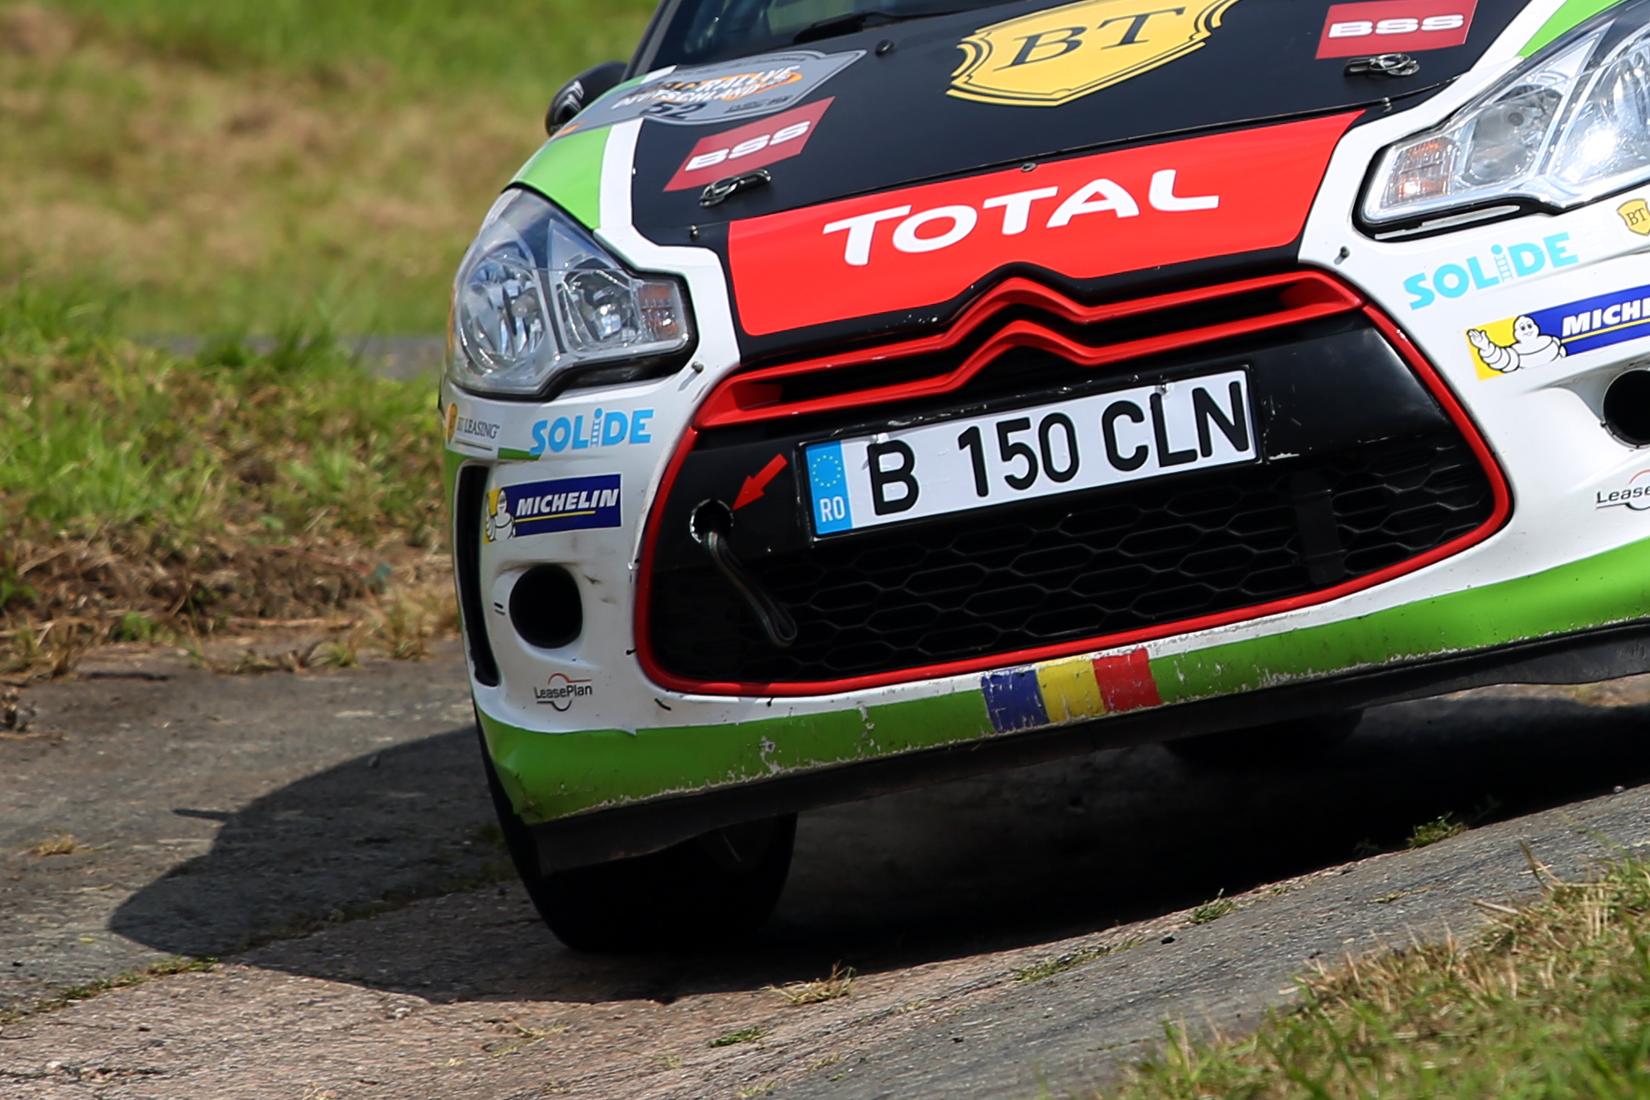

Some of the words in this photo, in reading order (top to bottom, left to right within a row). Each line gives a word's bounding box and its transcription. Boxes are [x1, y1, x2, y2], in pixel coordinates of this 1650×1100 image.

[992, 6, 1186, 72] BT
[1328, 14, 1465, 39] BSS
[696, 64, 801, 93] RALLYE
[682, 121, 812, 173] BSS
[822, 169, 1221, 266] TOTAL
[1625, 207, 1648, 227] BT
[464, 418, 500, 439] LEASING
[867, 439, 920, 517] B
[957, 412, 1081, 498] 150
[1101, 380, 1250, 472] CLN
[515, 487, 620, 517] MICHELIN
[820, 495, 846, 522] RO
[533, 681, 593, 700] LeasePlan
